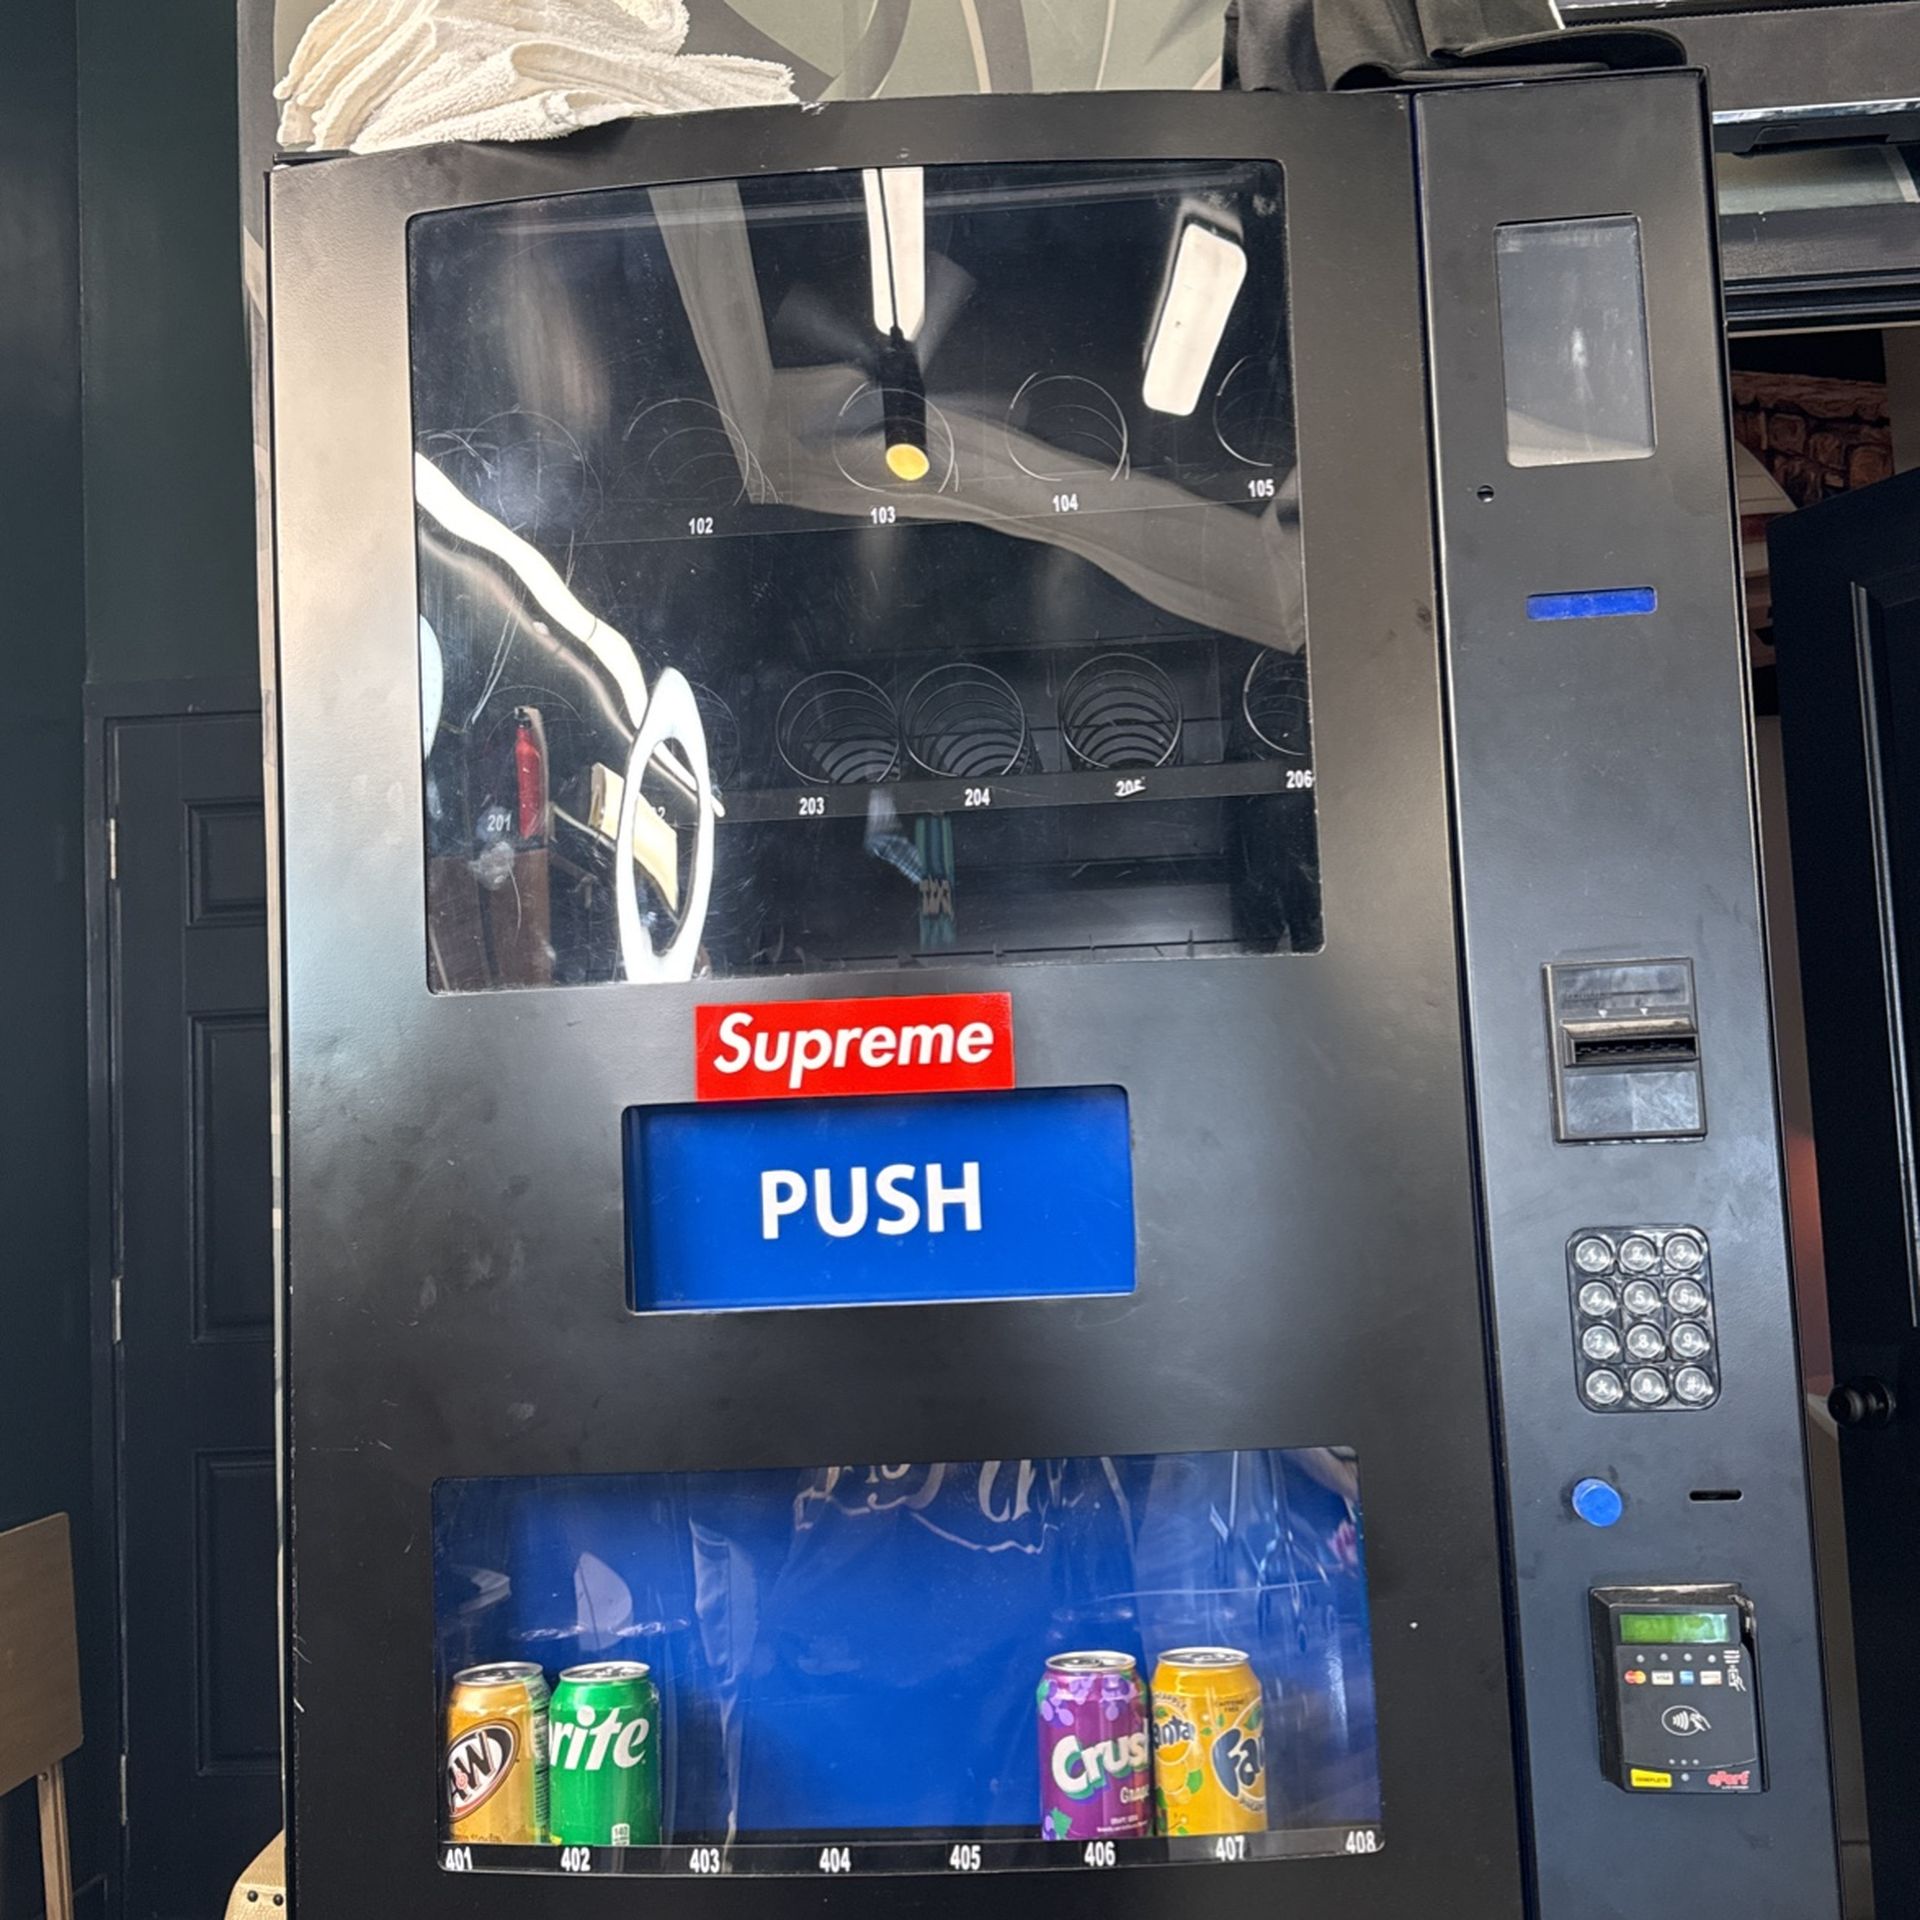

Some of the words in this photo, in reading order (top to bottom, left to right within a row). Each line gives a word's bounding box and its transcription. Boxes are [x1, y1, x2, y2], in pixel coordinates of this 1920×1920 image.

[1249, 479, 1275, 499] 105
[870, 505, 896, 526] 103
[1053, 493, 1079, 513] 104
[688, 516, 714, 536] 102
[1285, 769, 1313, 789] 206
[799, 797, 825, 816] 203
[964, 787, 991, 806] 204
[487, 813, 512, 832] 201
[713, 1012, 994, 1090] Supreme
[760, 1161, 982, 1241] PUSH
[549, 1705, 650, 1771] rite
[1152, 1716, 1197, 1750] anta
[1211, 1728, 1266, 1798] Fa
[1084, 1841, 1116, 1867] 406
[1215, 1835, 1246, 1861] 407
[1345, 1829, 1377, 1854] 408
[444, 1846, 473, 1872] 401
[560, 1847, 591, 1872] 402
[689, 1848, 720, 1873] 403
[819, 1847, 851, 1873] 404
[950, 1845, 981, 1870] 405
